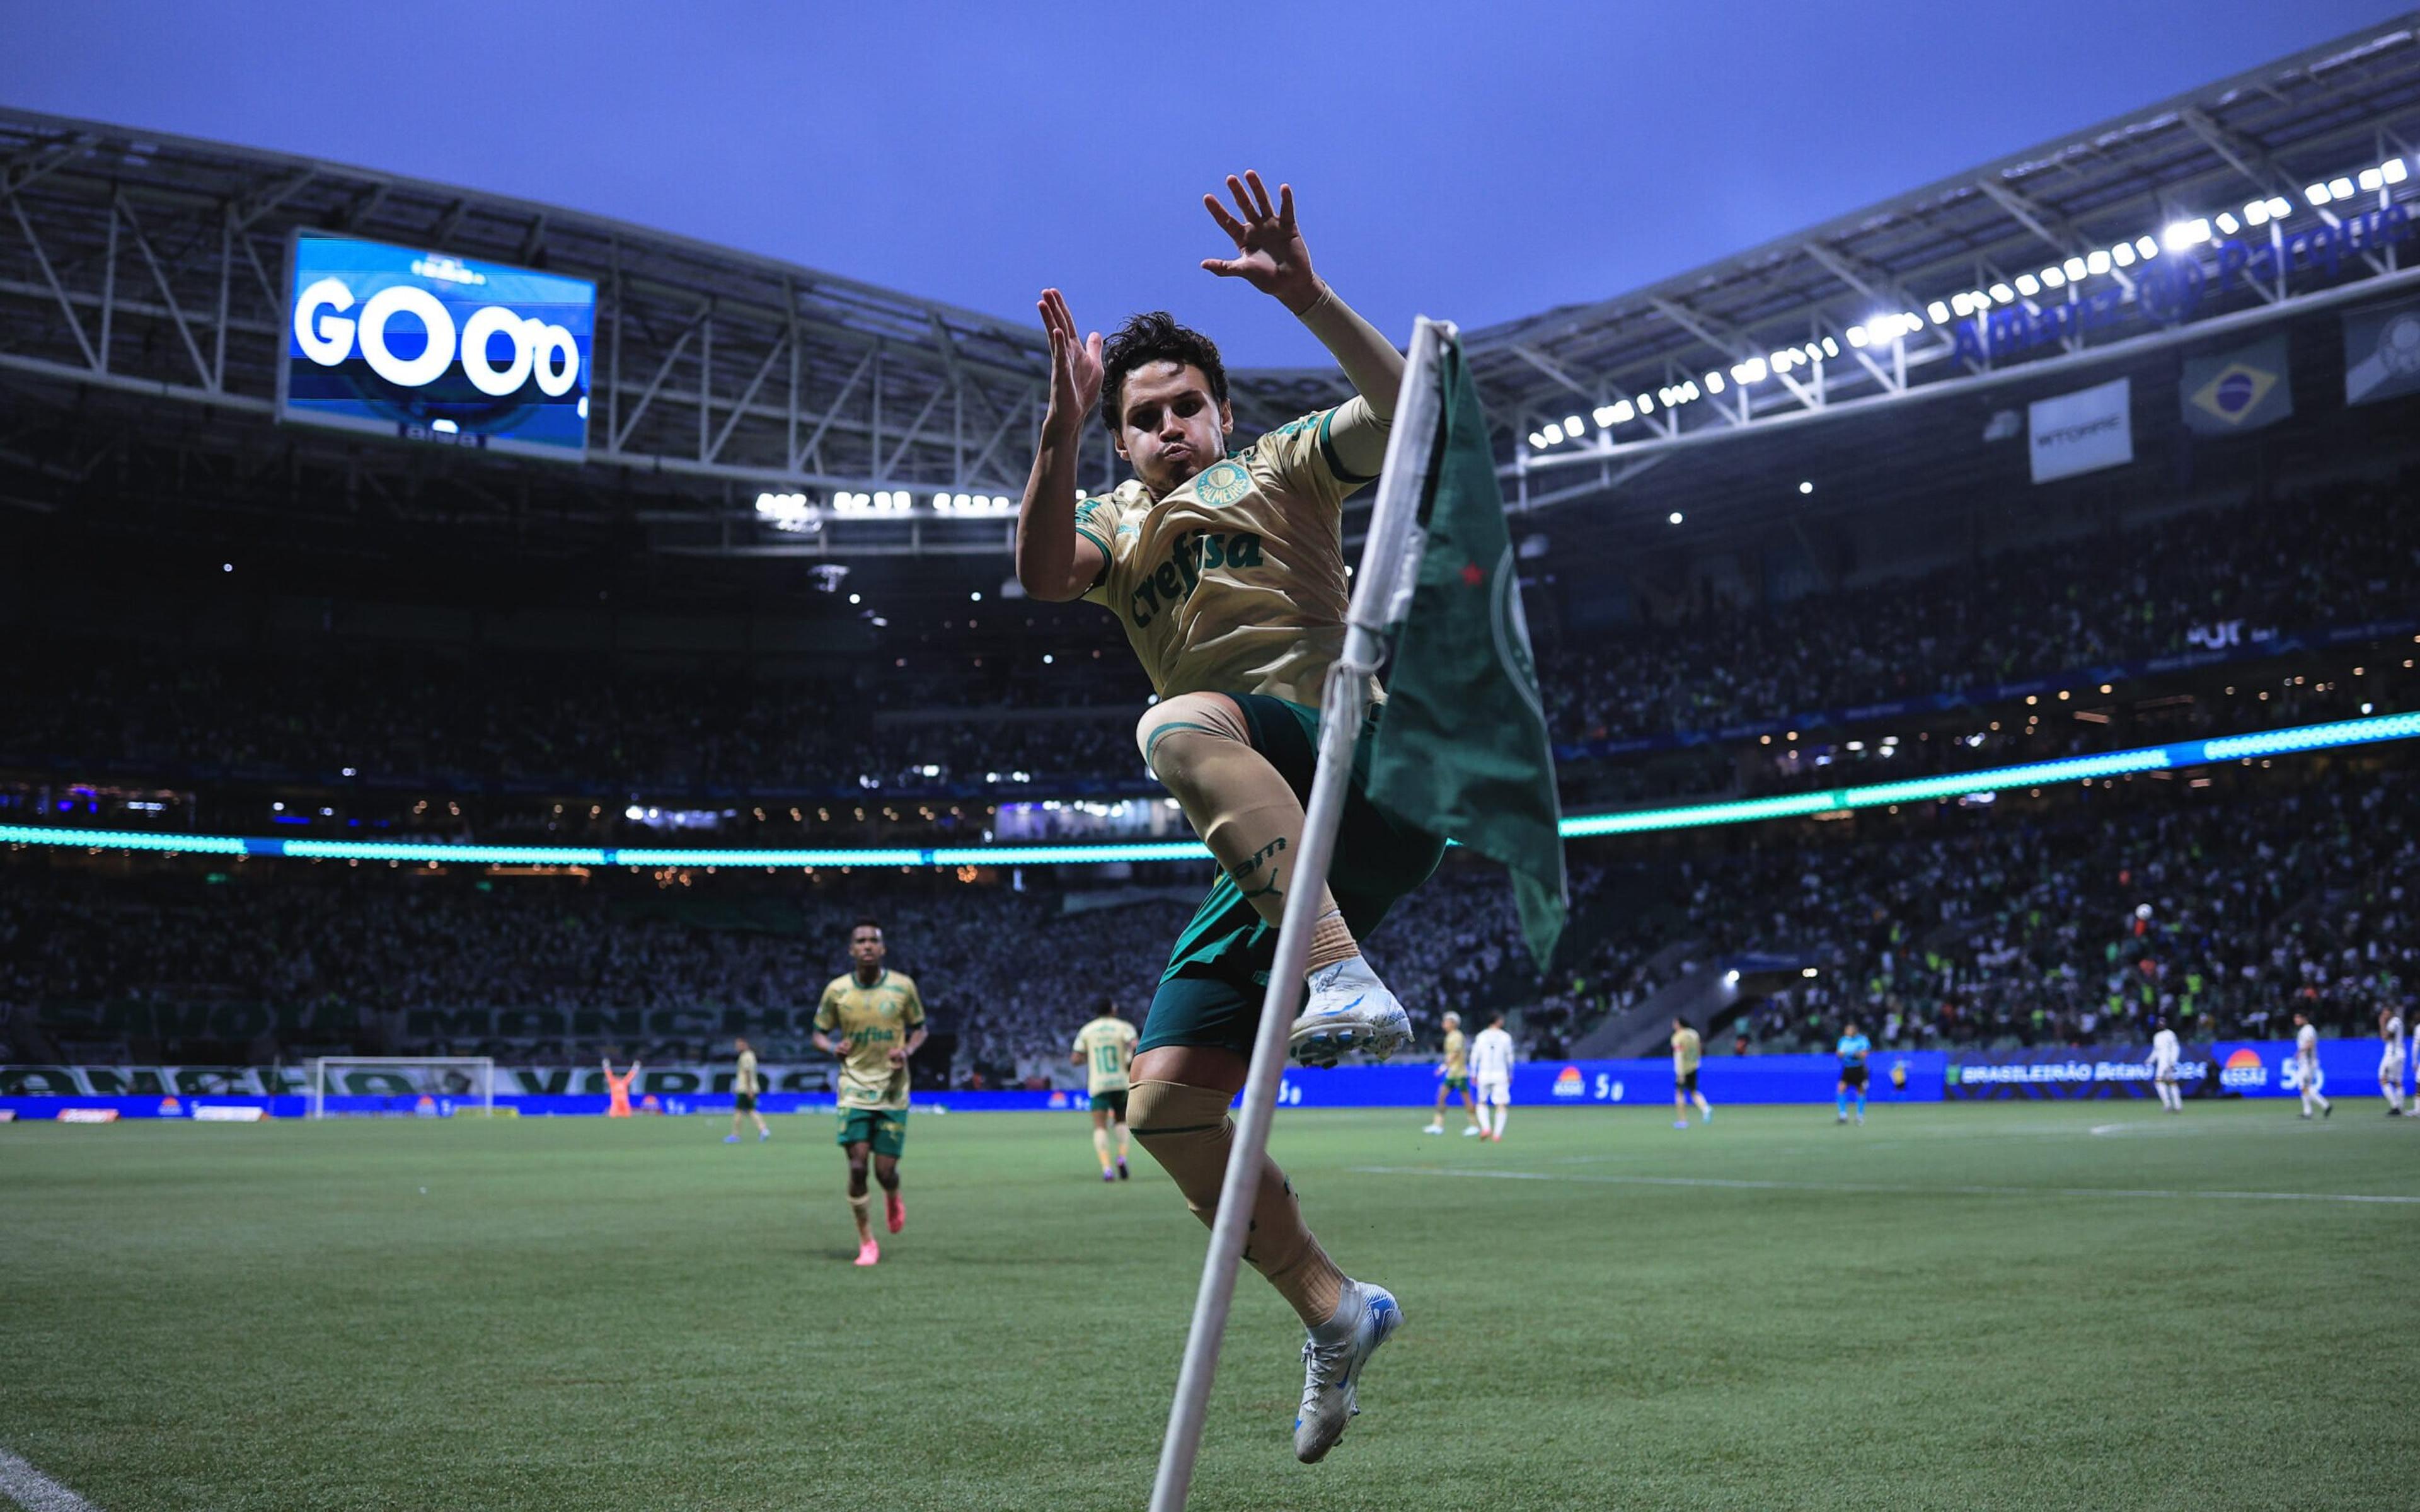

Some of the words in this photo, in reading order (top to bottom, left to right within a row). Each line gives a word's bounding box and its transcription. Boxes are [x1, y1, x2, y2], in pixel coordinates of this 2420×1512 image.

[2218, 203, 2409, 292] Parque
[1198, 478, 1247, 503] PALMEIRAS
[1132, 528, 1264, 629] crefisa
[1094, 1045, 1119, 1074] 10
[1961, 1060, 2093, 1084] BRASILEIRÃO
